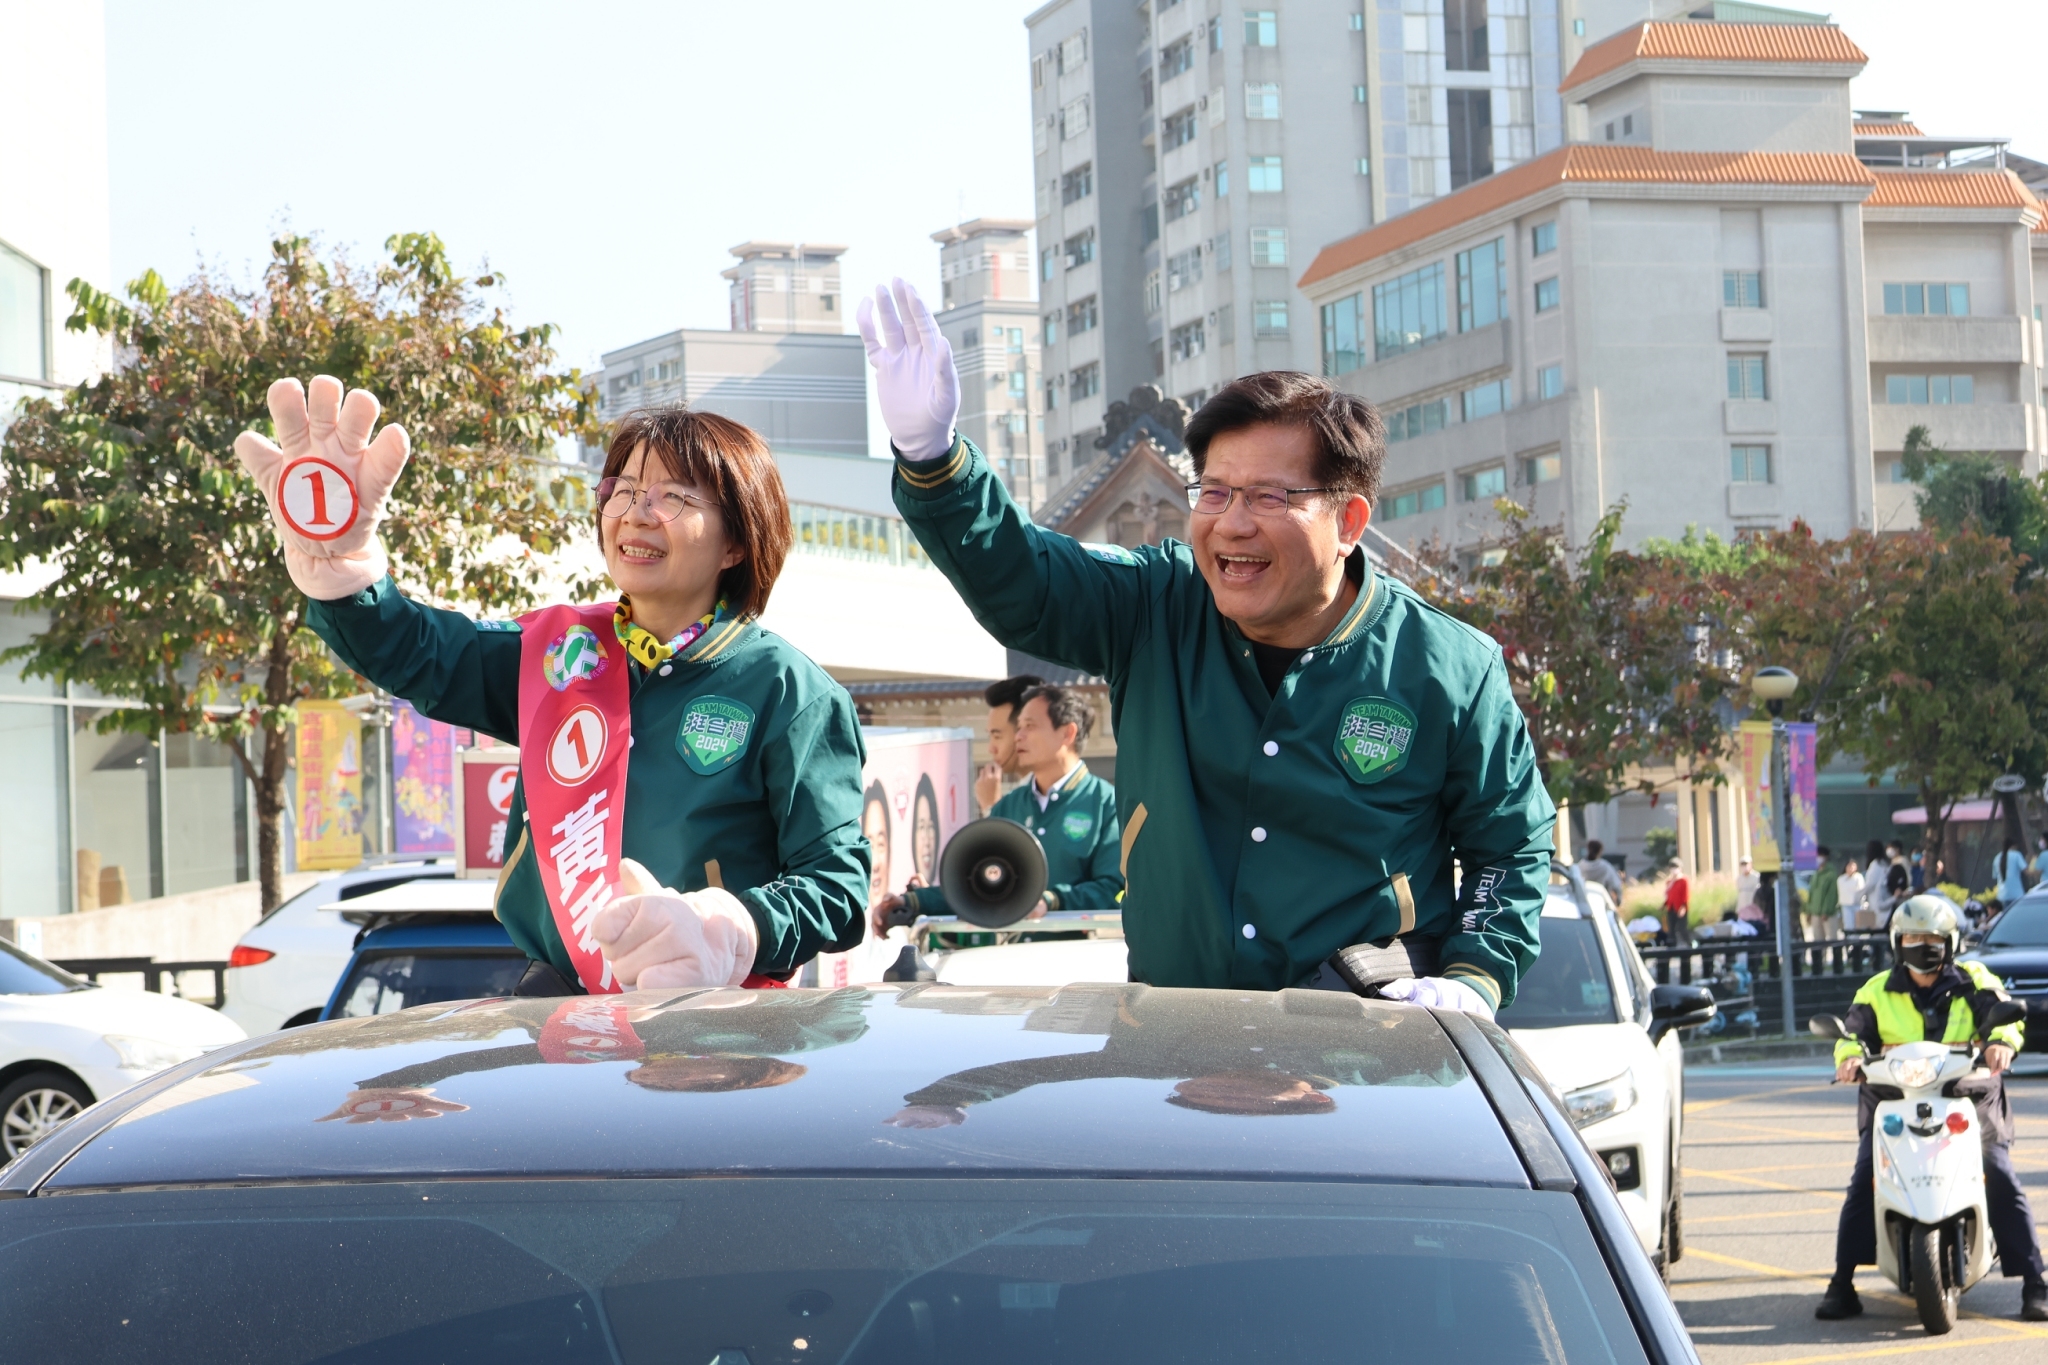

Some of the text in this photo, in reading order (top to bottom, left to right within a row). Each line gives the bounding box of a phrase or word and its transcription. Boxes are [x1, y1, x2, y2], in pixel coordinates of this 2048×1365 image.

[301, 470, 336, 526] 1
[692, 703, 749, 721] TEAM TAIWAN
[1351, 704, 1412, 728] TEAM TAIWAN
[567, 718, 589, 769] 1
[682, 712, 750, 746] 挺台灣
[695, 735, 729, 753] 2024
[1340, 714, 1412, 754] 挺台灣
[1353, 740, 1389, 761] 2024
[1473, 873, 1497, 903] TEAM
